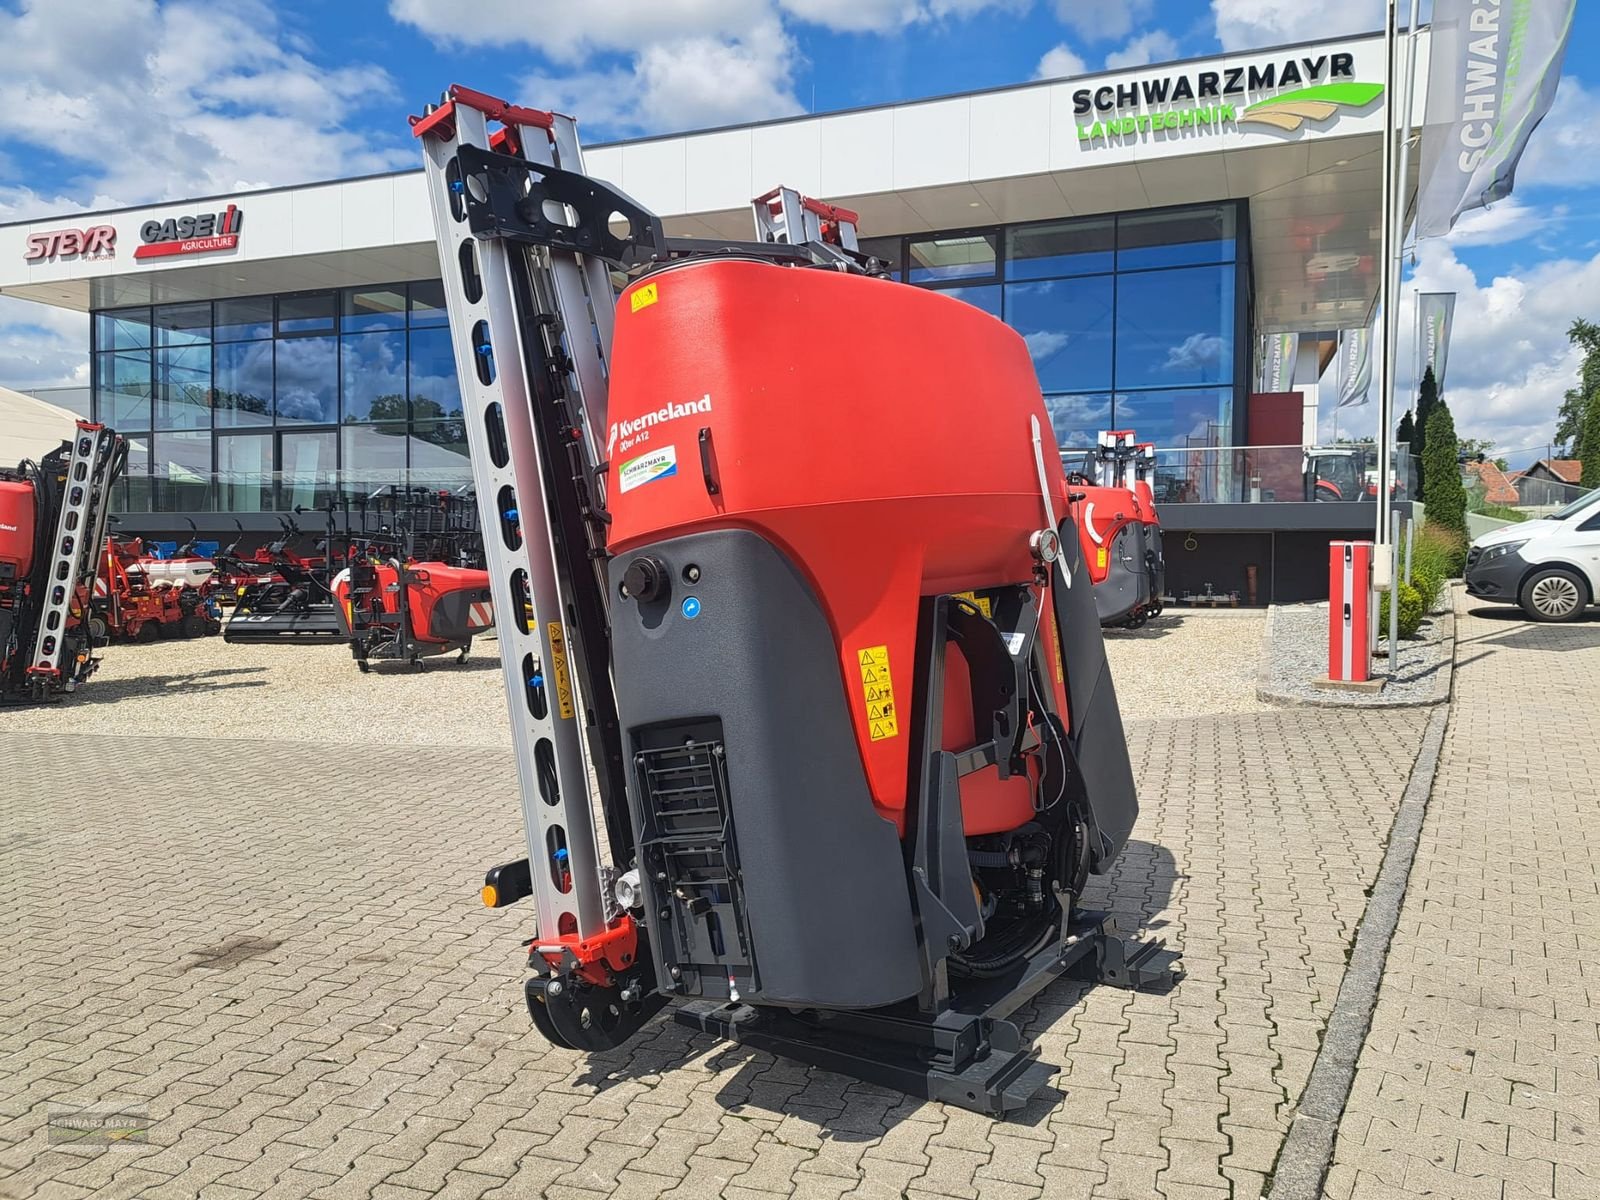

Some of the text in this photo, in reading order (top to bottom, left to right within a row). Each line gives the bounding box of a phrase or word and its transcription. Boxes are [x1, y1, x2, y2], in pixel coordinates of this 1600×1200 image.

[1072, 52, 1355, 114] SCHWARZMAYR
[1076, 103, 1238, 140] LANDTECHNIK
[23, 225, 117, 260] STEYR
[140, 213, 216, 243] CASE
[181, 236, 233, 252] AGRICULTURE
[619, 393, 712, 440] Kverneland
[635, 430, 650, 445] A12
